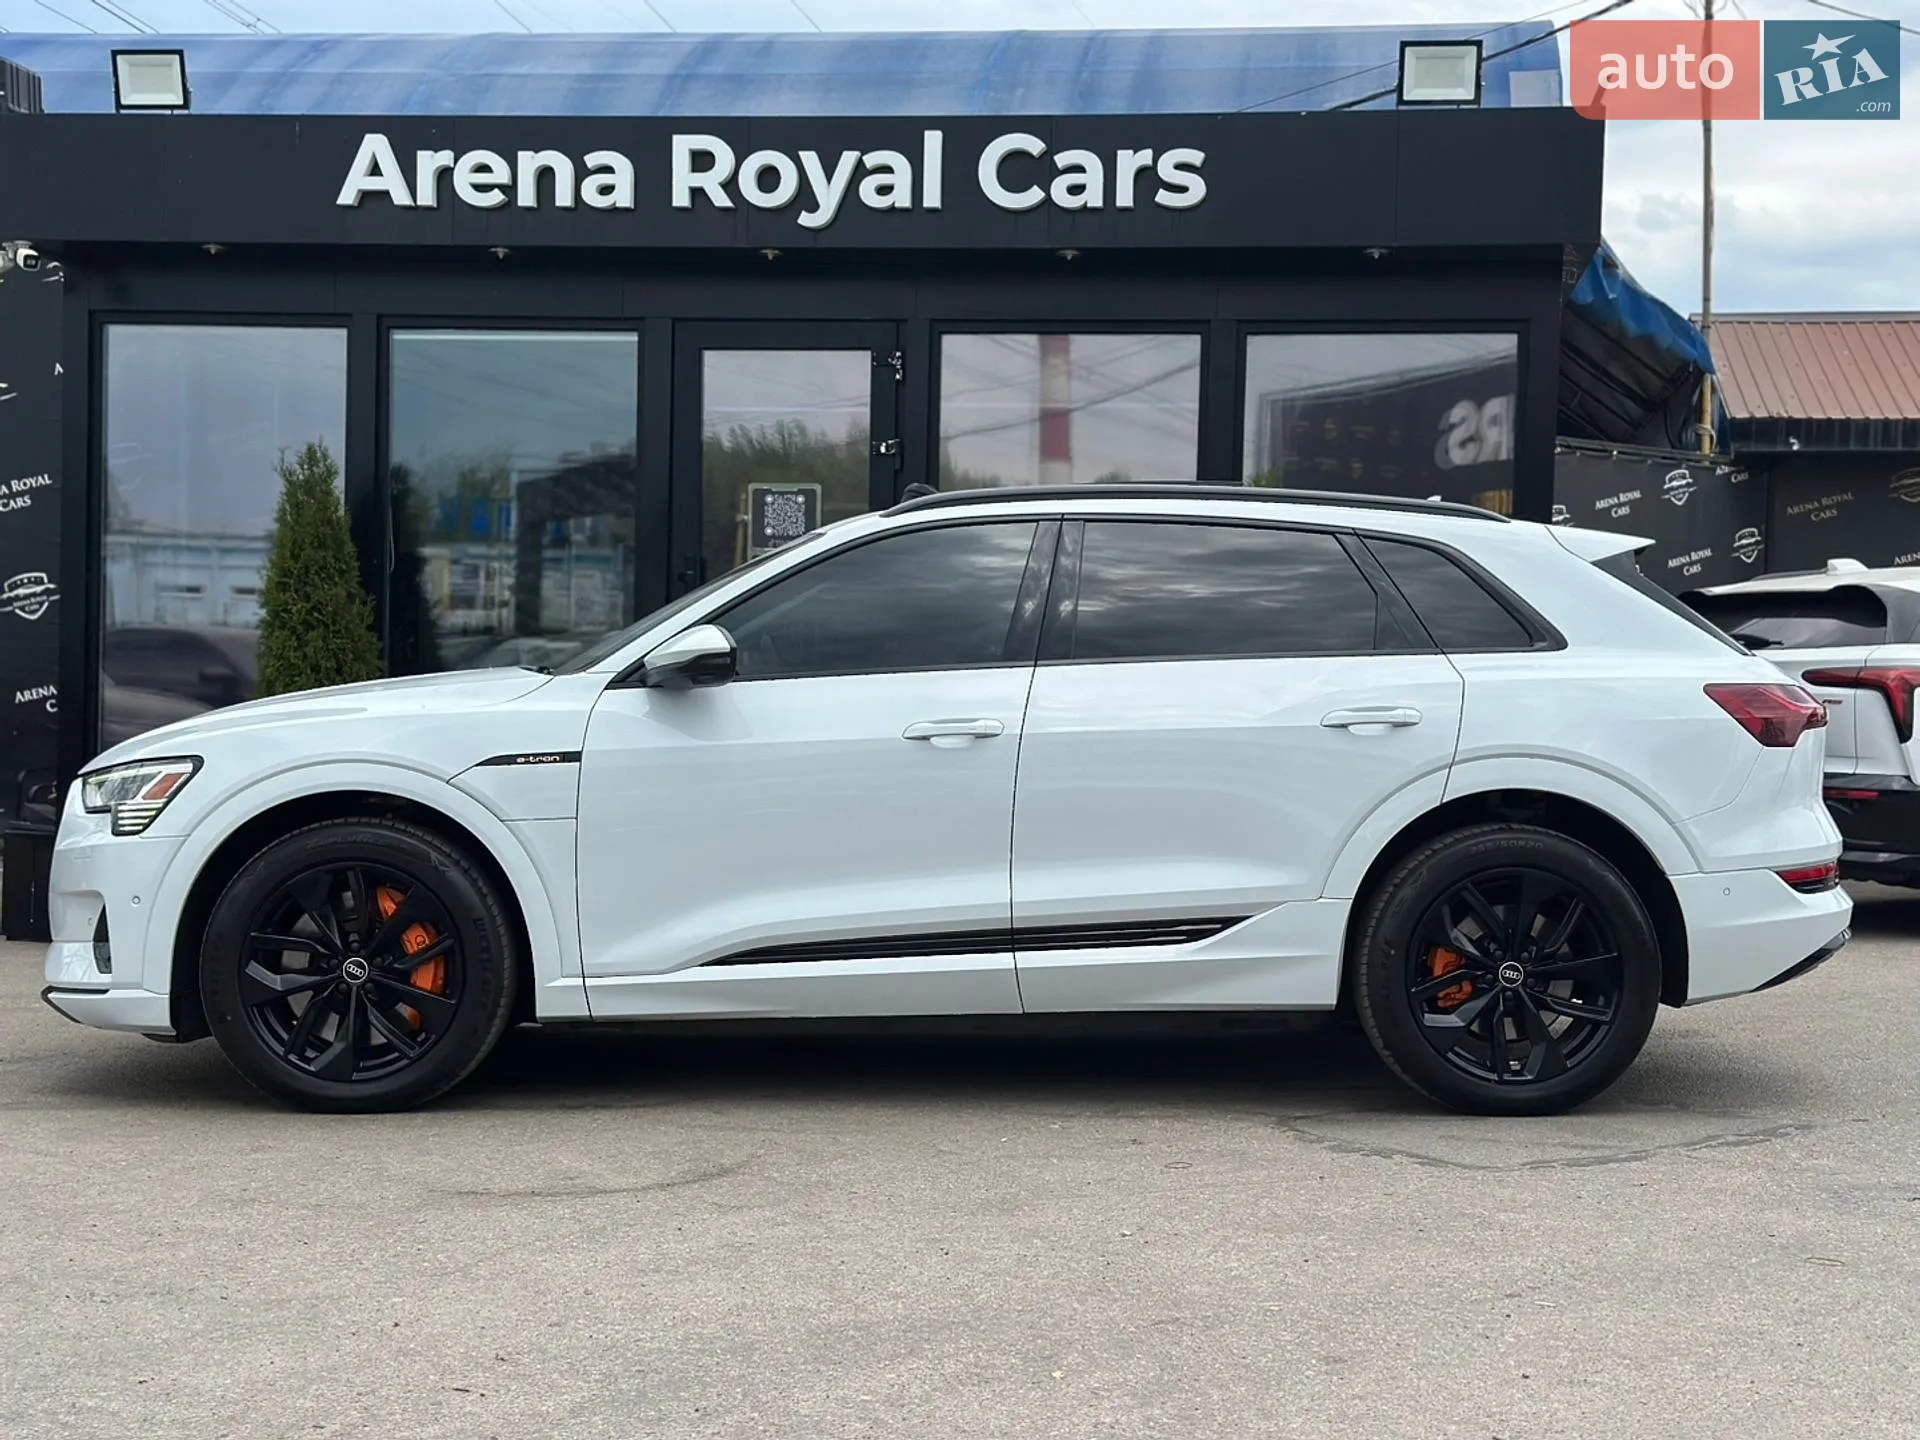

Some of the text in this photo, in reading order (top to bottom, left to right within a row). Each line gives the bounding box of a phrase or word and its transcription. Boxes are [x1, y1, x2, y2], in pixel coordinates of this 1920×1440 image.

[336, 130, 1208, 230] Arena Royal Cars
[10, 473, 53, 492] ROYAL
[1786, 492, 1855, 516] ARENA ROYAL
[1810, 508, 1838, 521] CARS
[15, 685, 58, 704] ARENA
[516, 755, 560, 763] e-tron
